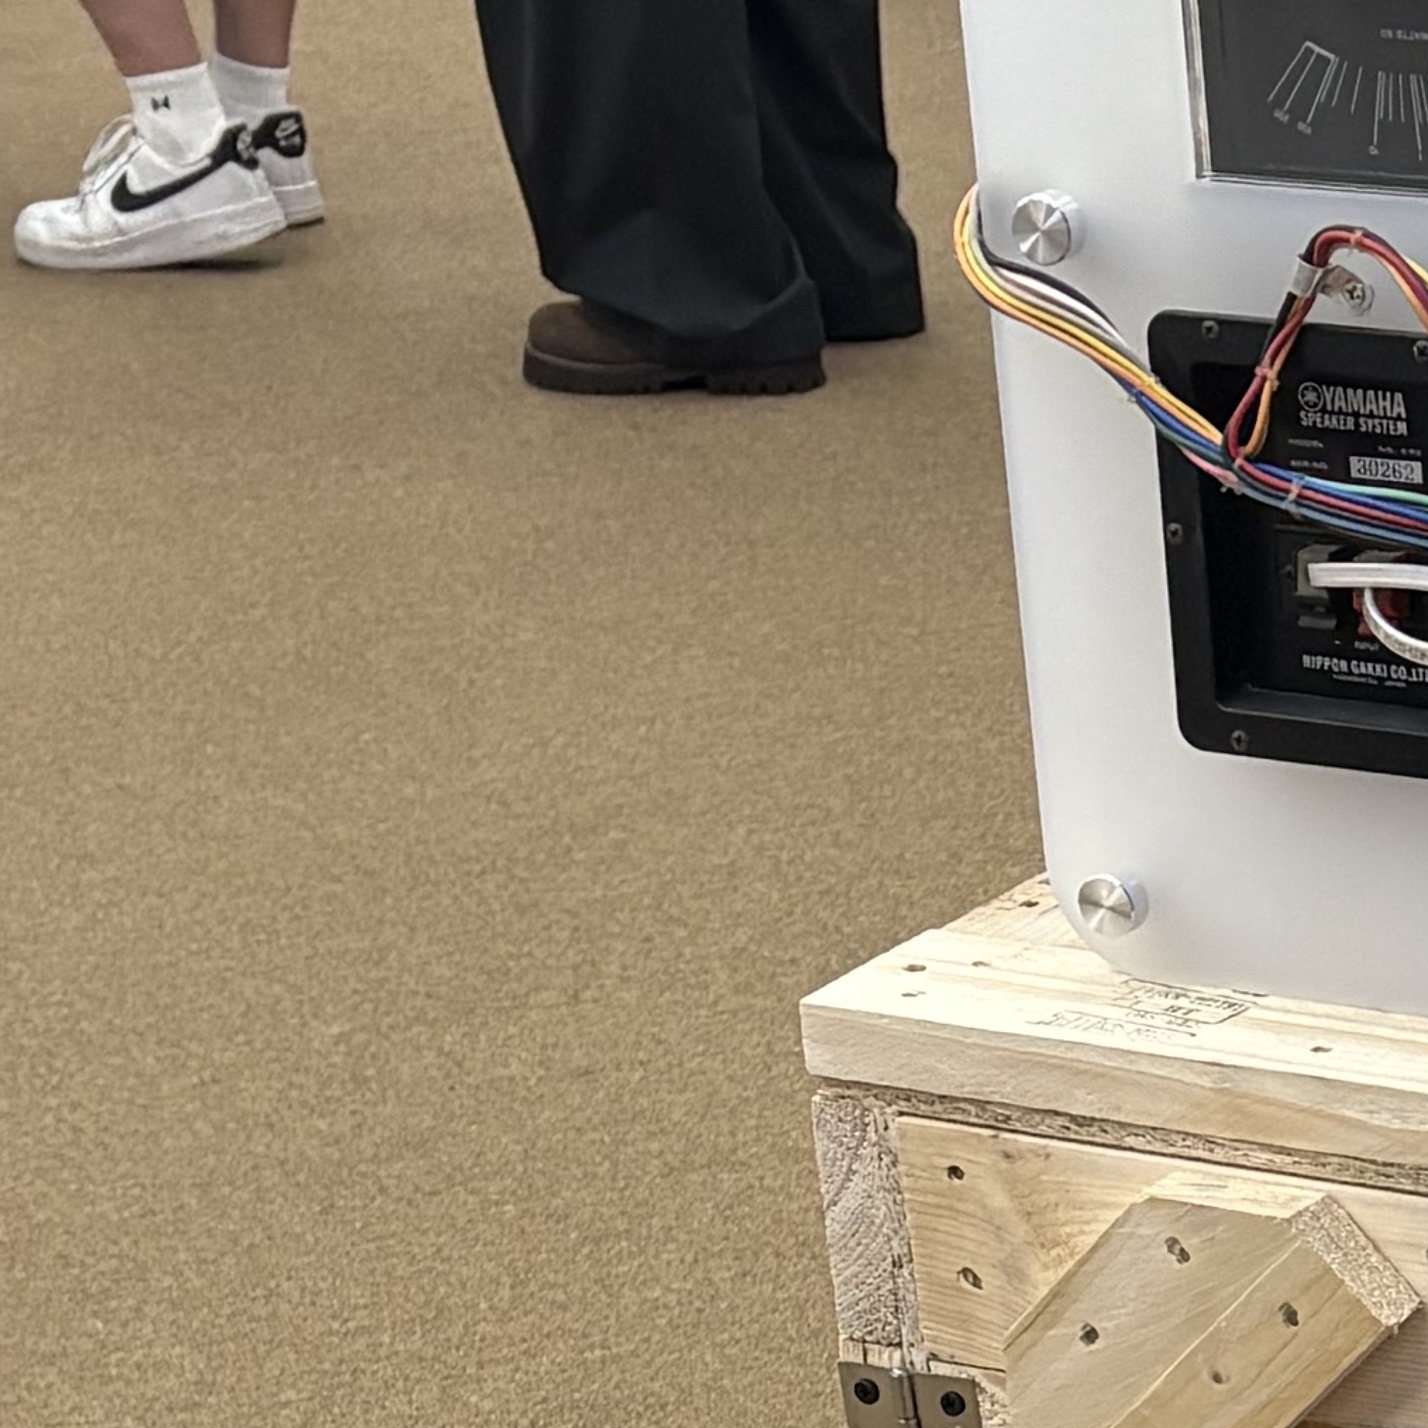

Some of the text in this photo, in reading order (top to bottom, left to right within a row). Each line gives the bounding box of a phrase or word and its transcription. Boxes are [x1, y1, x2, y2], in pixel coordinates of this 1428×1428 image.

[1322, 384, 1406, 419] YAMAHA
[1300, 411, 1408, 436] SPEAKER SYSTEM
[1358, 458, 1414, 481] 30262
[1302, 654, 1349, 673] NIPPON
[1350, 660, 1388, 678] GAKKI
